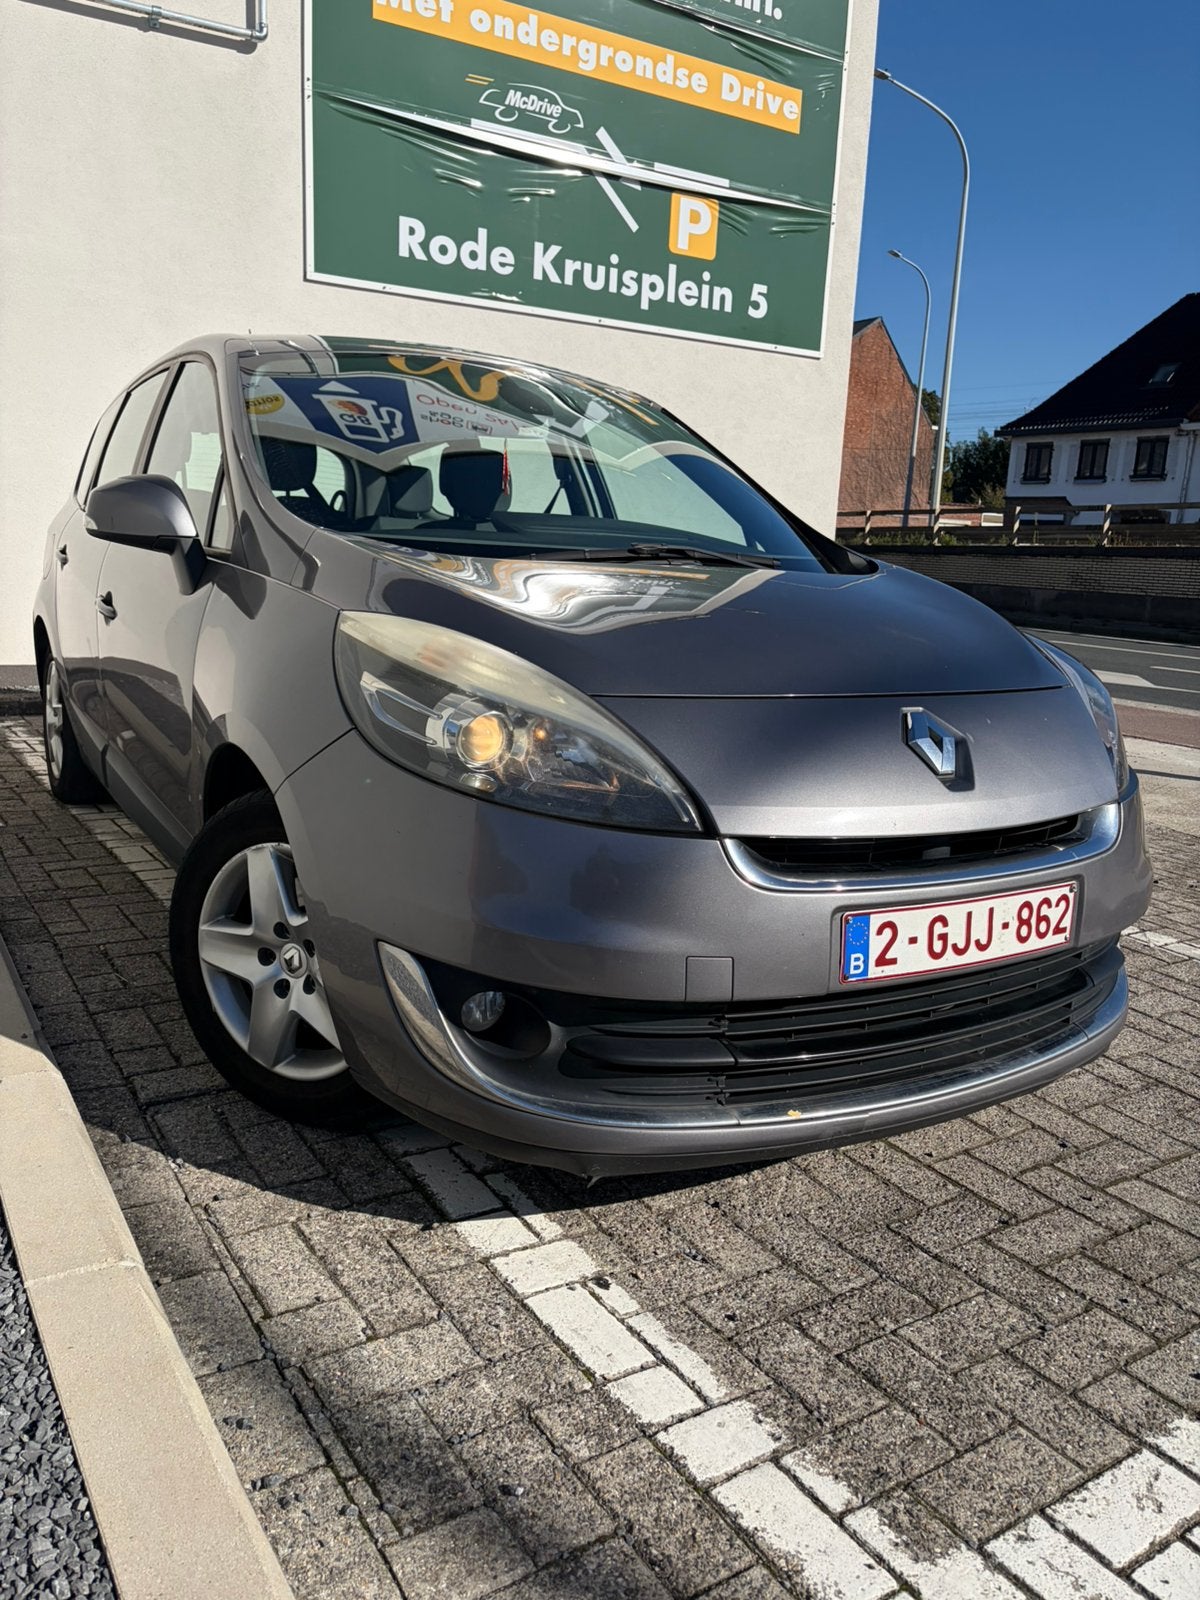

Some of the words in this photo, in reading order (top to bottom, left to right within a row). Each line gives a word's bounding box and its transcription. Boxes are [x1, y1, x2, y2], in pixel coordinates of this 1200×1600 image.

[376, 0, 454, 23] et
[470, 8, 708, 94] ondergrondse
[721, 72, 799, 120] Drive
[504, 89, 562, 117] McDrive
[677, 196, 711, 250] P
[398, 215, 515, 275] Rode
[533, 241, 733, 310] Kruisplein
[747, 283, 768, 319] 5
[875, 893, 1071, 967] 2-GJJ-862
[850, 953, 865, 974] B
